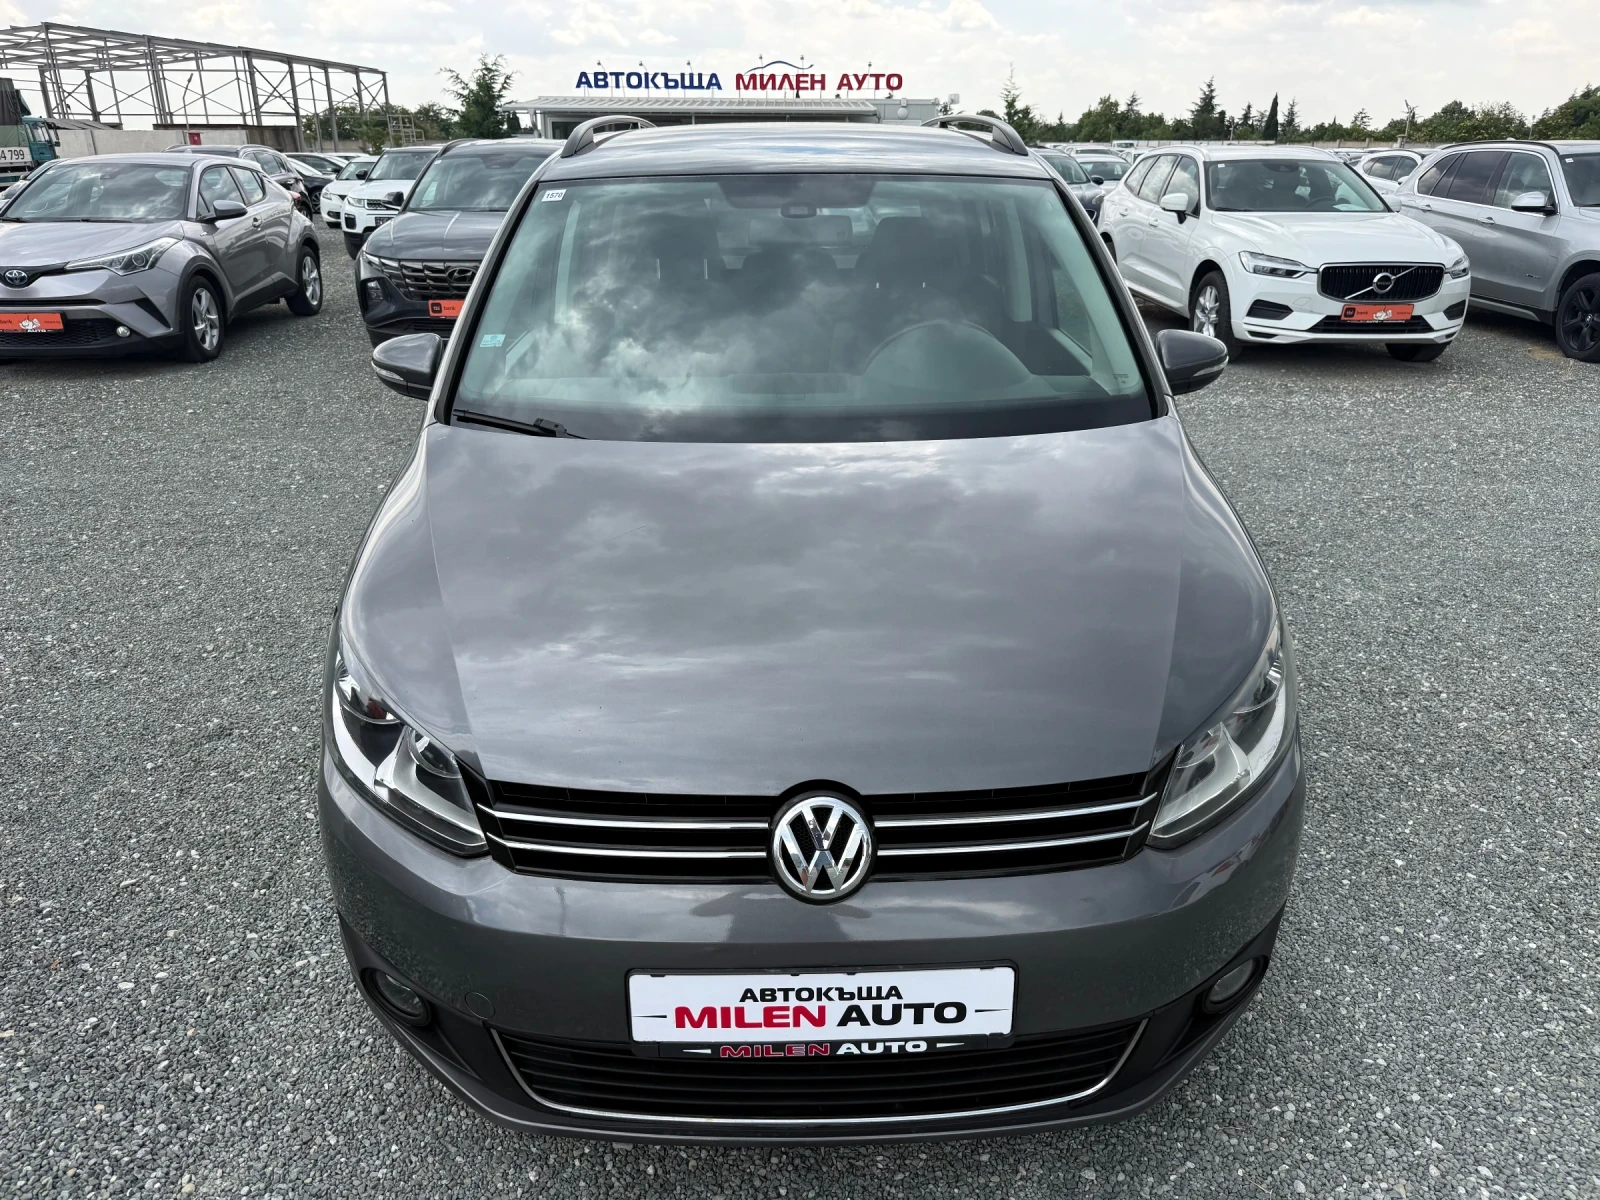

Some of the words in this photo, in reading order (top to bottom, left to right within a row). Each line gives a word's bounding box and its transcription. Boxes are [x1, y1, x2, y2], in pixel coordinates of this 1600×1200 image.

[576, 71, 722, 90] АВТОКЪЩА
[736, 73, 826, 91] МИЛЕН
[837, 73, 903, 91] АУТО
[739, 985, 904, 1003] АВТОКЪЩА
[674, 1005, 826, 1029] MILEN
[836, 1001, 968, 1027] AUTO
[719, 1043, 831, 1058] MILEN
[836, 1040, 928, 1055] AUTO
